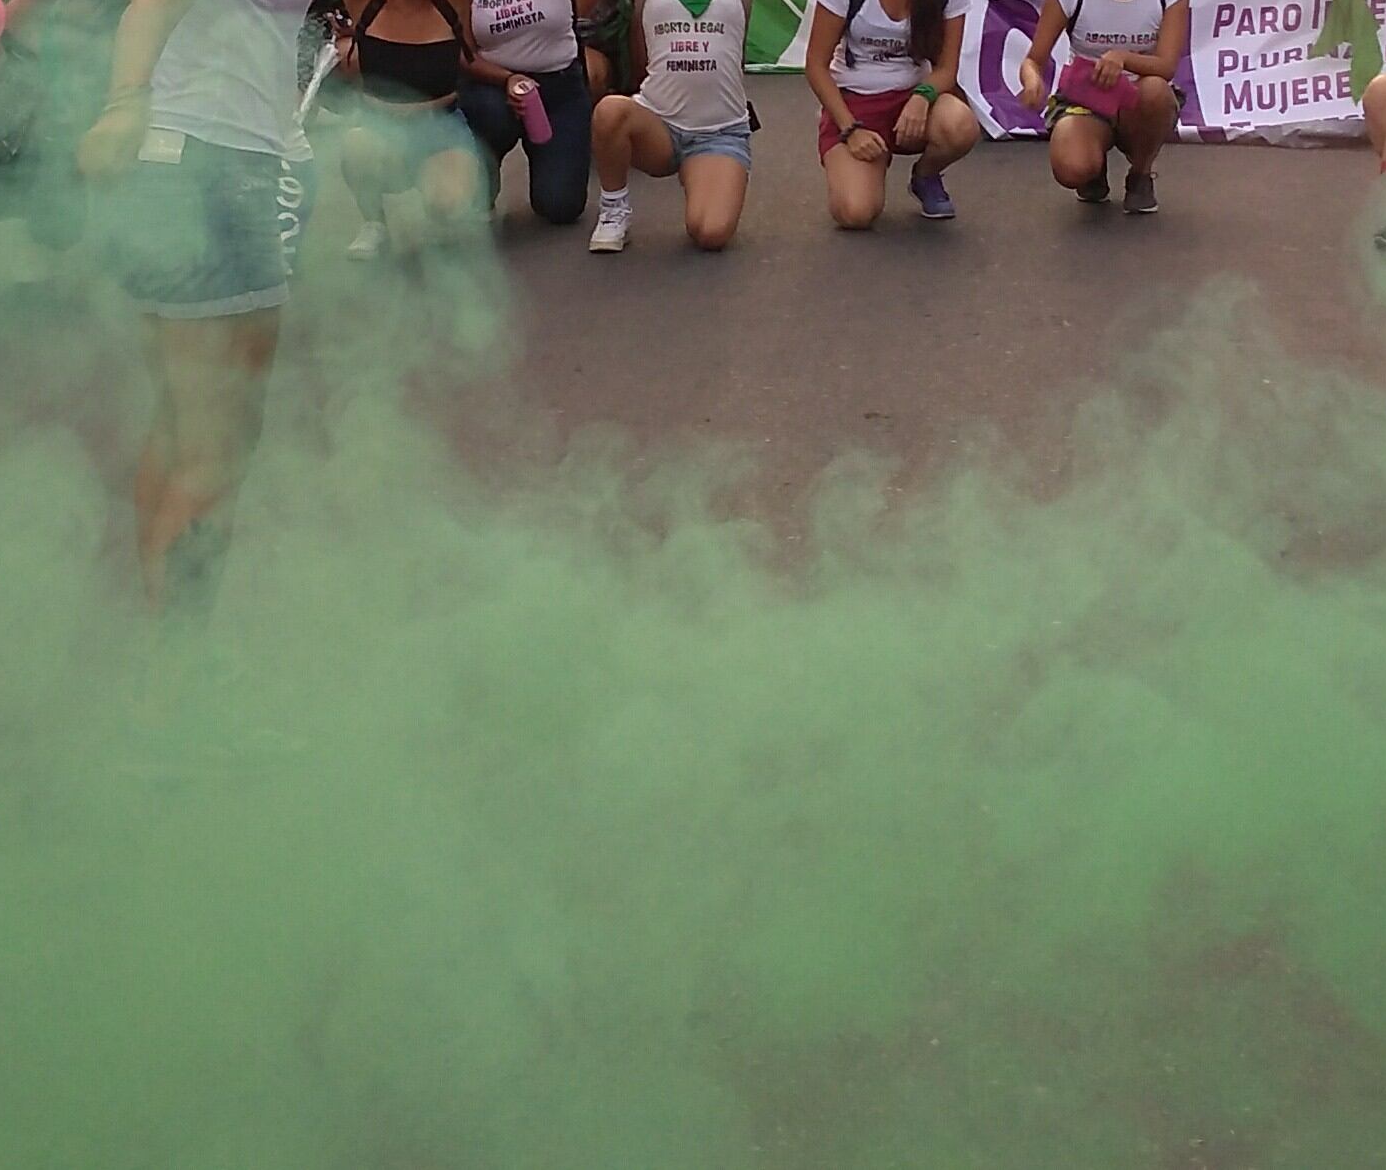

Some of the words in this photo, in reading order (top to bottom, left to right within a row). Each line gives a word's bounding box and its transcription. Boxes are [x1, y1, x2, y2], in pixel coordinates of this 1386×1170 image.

[495, 4, 524, 21] LIBRE
[526, 1, 533, 12] Y
[489, 11, 545, 35] FEMINISTA
[1213, 2, 1302, 38] PARO
[654, 22, 691, 35] ABORTO
[694, 22, 725, 34] LEGAL
[860, 36, 902, 47] ABORTO
[1084, 32, 1127, 44] ABORTO
[1131, 32, 1158, 44] LEGA
[670, 41, 699, 52] LIBRE
[702, 41, 709, 53] Y
[666, 59, 717, 72] FEMINISTA
[1223, 70, 1353, 115] MUJERE
